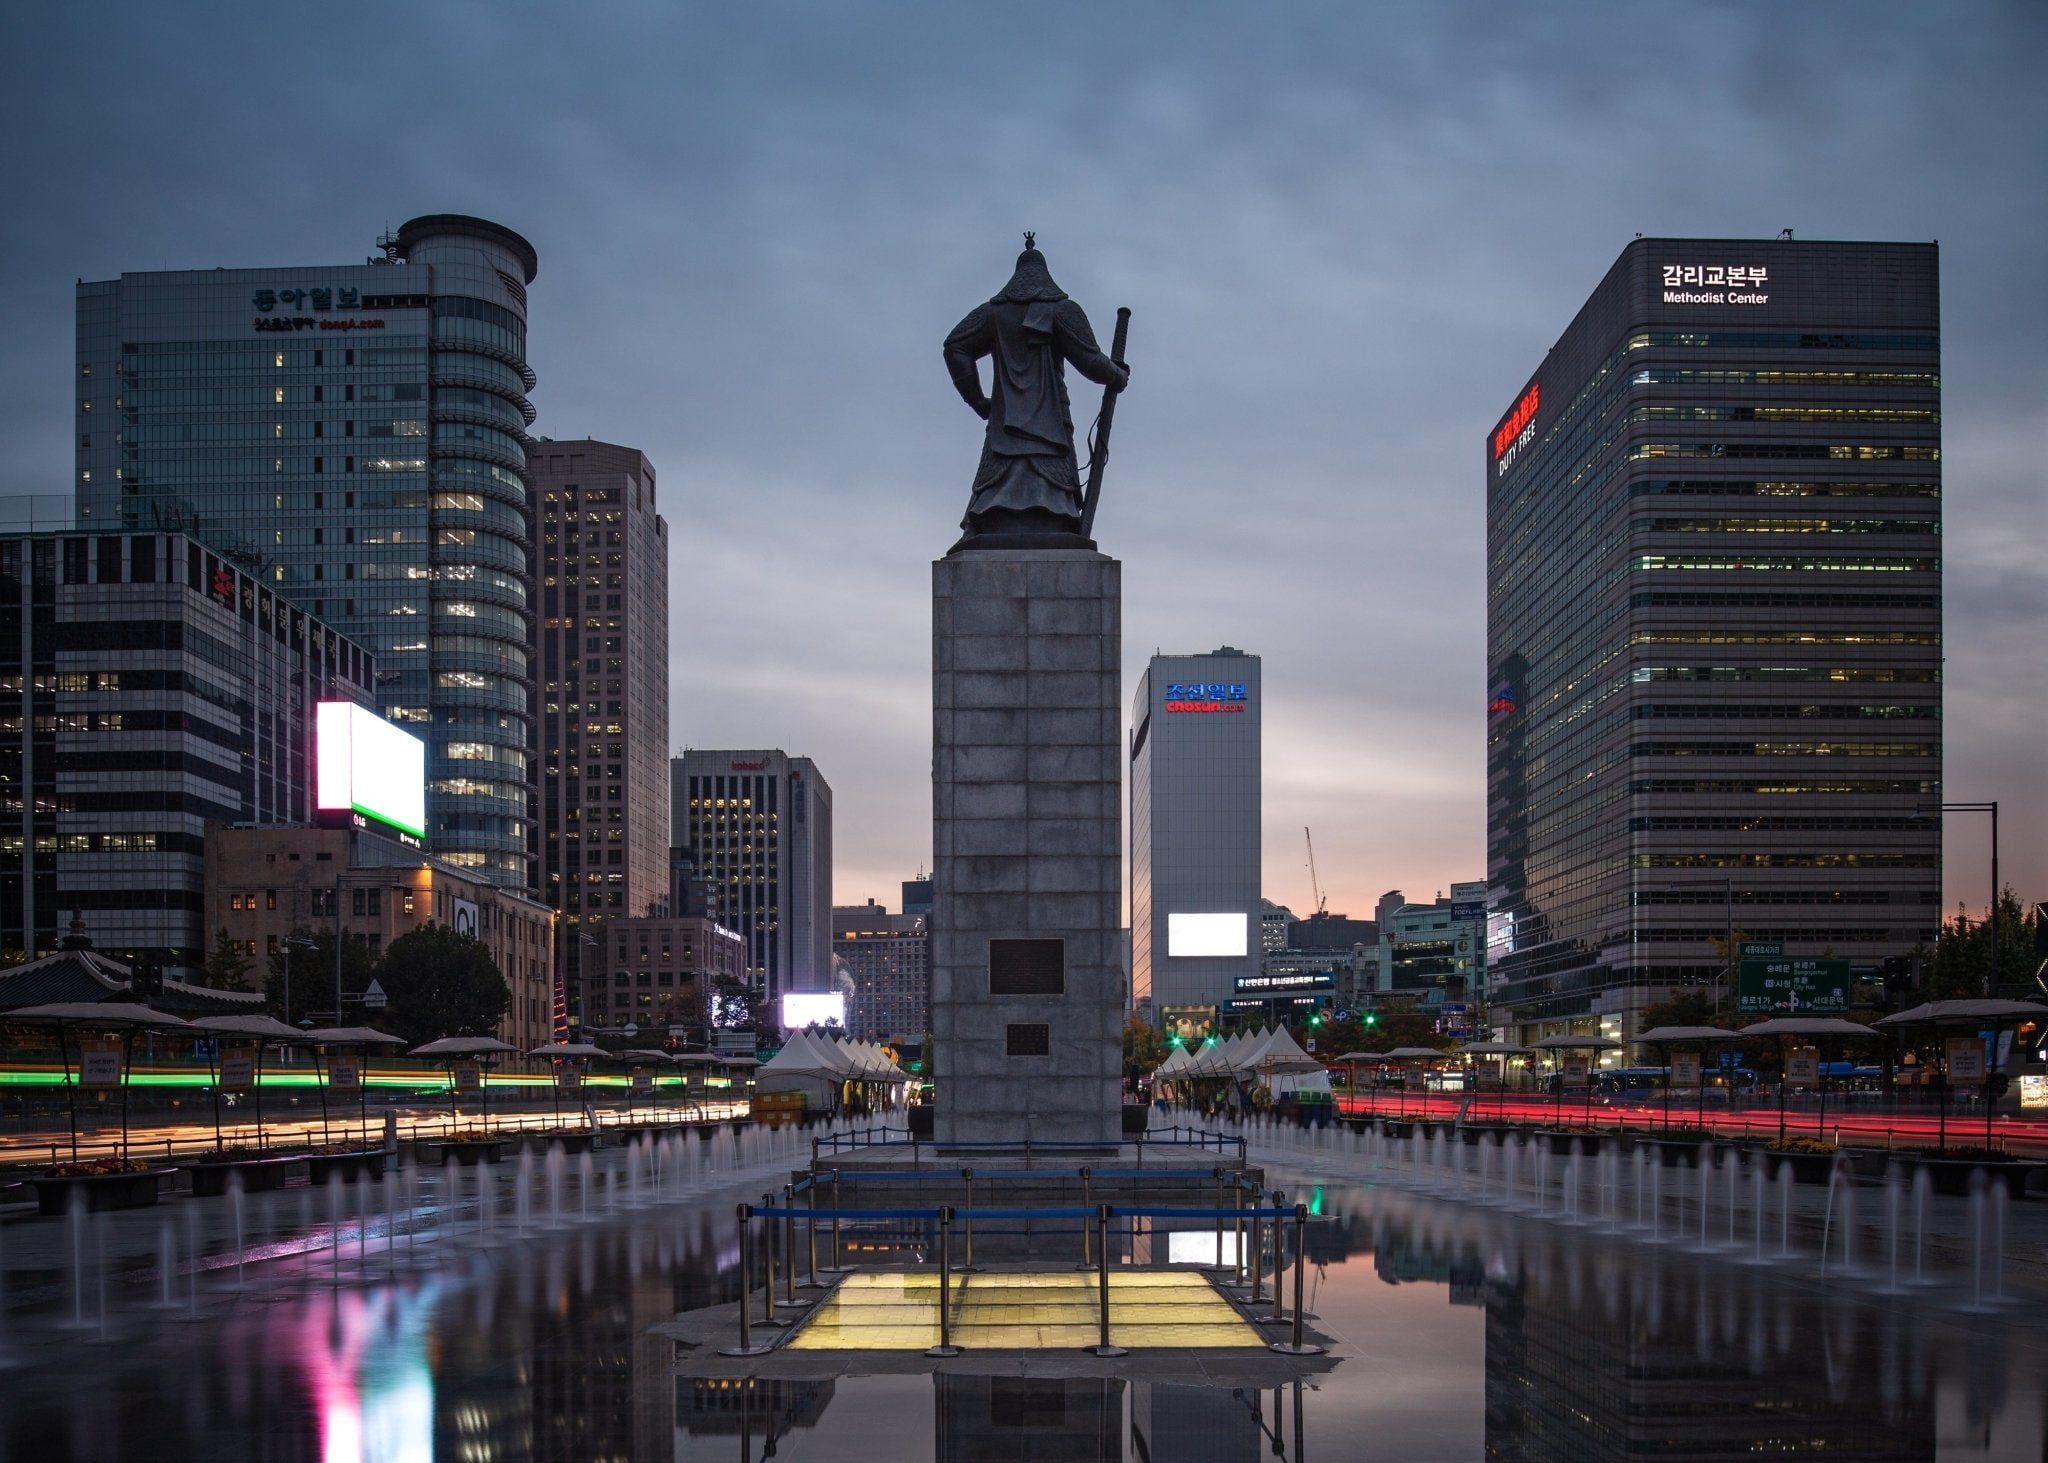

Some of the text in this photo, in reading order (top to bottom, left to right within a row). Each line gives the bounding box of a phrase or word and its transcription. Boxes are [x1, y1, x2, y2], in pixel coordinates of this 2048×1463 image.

[1663, 265, 1768, 287] 감리교본부
[252, 287, 360, 312] 동아일보
[1663, 292, 1768, 304] Methodist Center
[1499, 418, 1536, 476] DUTY FREE
[1164, 683, 1247, 700] 조선일보
